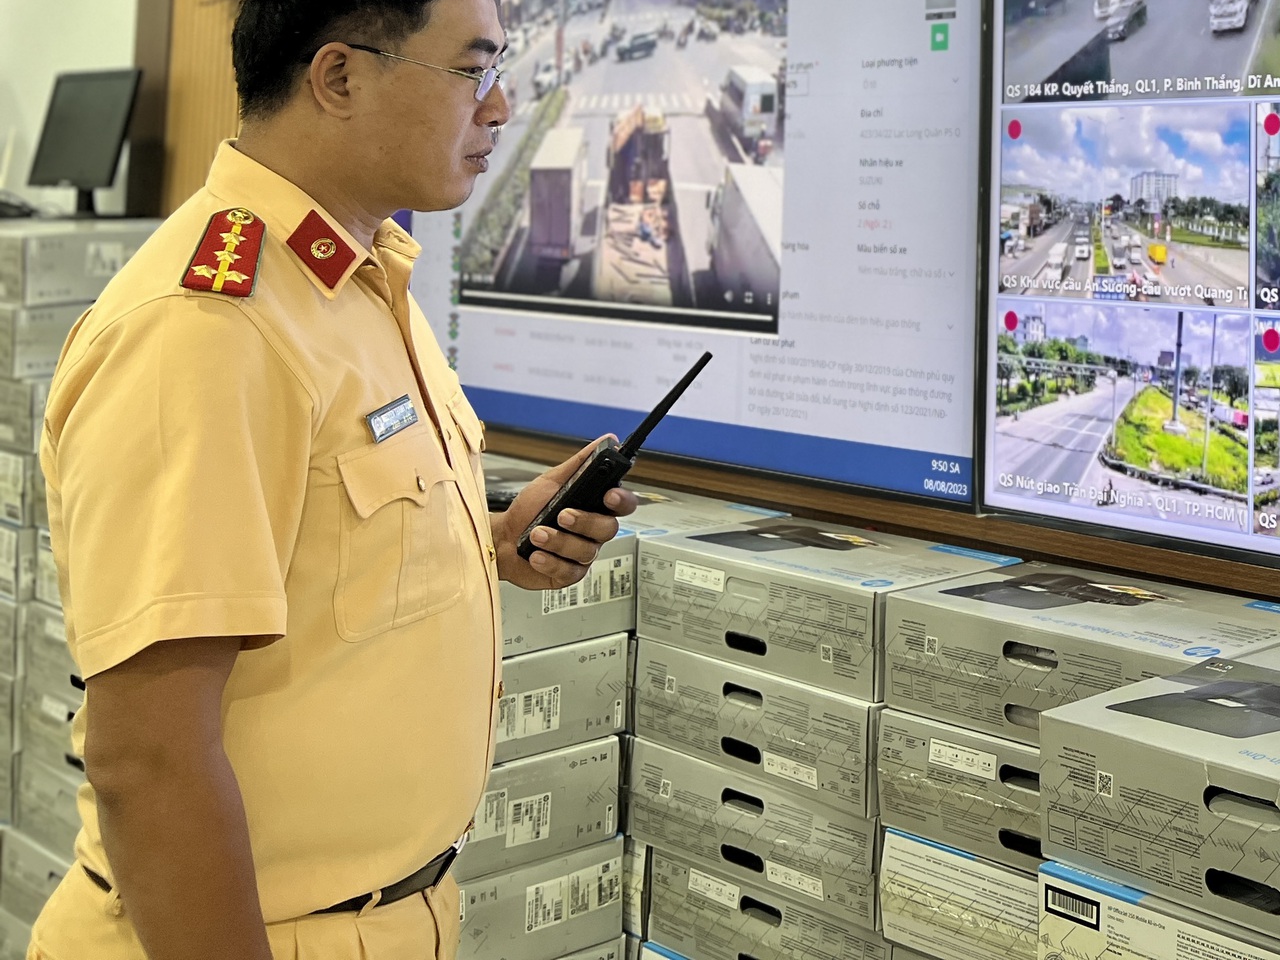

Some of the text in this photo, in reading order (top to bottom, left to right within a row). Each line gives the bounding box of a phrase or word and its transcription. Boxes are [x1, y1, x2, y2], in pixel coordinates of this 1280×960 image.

[1006, 84, 1020, 97] QS
[1024, 83, 1041, 96] 184
[1044, 82, 1059, 96] KP.
[1062, 80, 1094, 98] Quyết
[1096, 78, 1132, 96] Thắng,
[1135, 79, 1160, 94] QL1,
[1163, 78, 1173, 92] P.
[1176, 76, 1201, 91] Bình
[1204, 73, 1244, 92] Thắng,
[1248, 74, 1262, 88] Dĩ
[1002, 275, 1233, 303] QS Khu vực cầu An Sương-cầu vượt Quang
[1260, 286, 1279, 303] QS
[931, 459, 960, 474] 9:50 SA
[923, 478, 968, 496] 08/08/2023
[1259, 512, 1278, 529] QS
